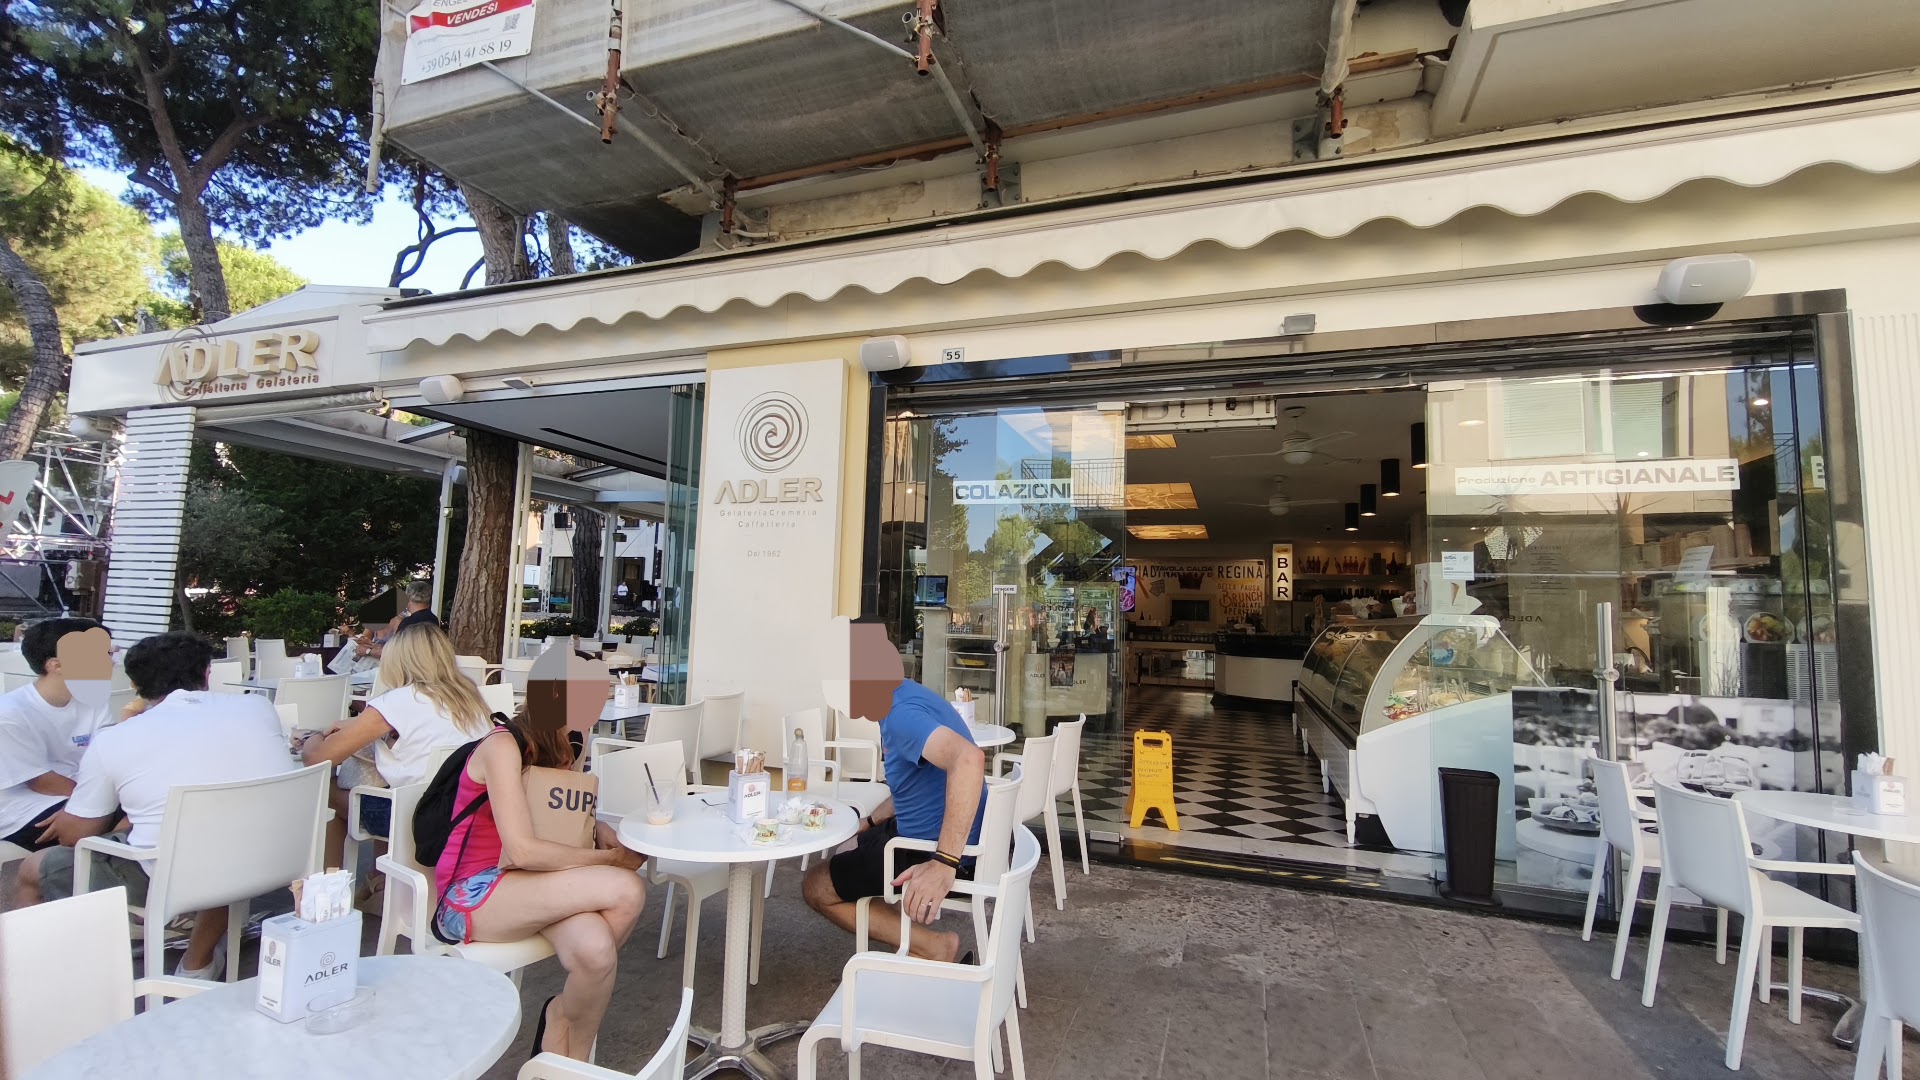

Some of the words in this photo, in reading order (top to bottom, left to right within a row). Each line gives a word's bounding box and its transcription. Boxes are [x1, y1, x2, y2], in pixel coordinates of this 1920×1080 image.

[447, 2, 498, 25] VENDESI
[479, 42, 495, 56] 88
[499, 39, 512, 52] 19
[153, 328, 320, 386] ADLER
[946, 351, 961, 361] 55
[256, 373, 320, 389] Gelateria
[1457, 475, 1537, 486] Produzione
[1539, 464, 1737, 487] ARTIGIANALE
[713, 476, 824, 505] ADLER
[955, 482, 1072, 500] COLAZIONI
[738, 520, 797, 529] Caffetteria
[1217, 565, 1264, 579] REGINA
[1277, 557, 1289, 598] BAR
[264, 955, 282, 967] ADLER
[304, 962, 349, 985] ADLER
